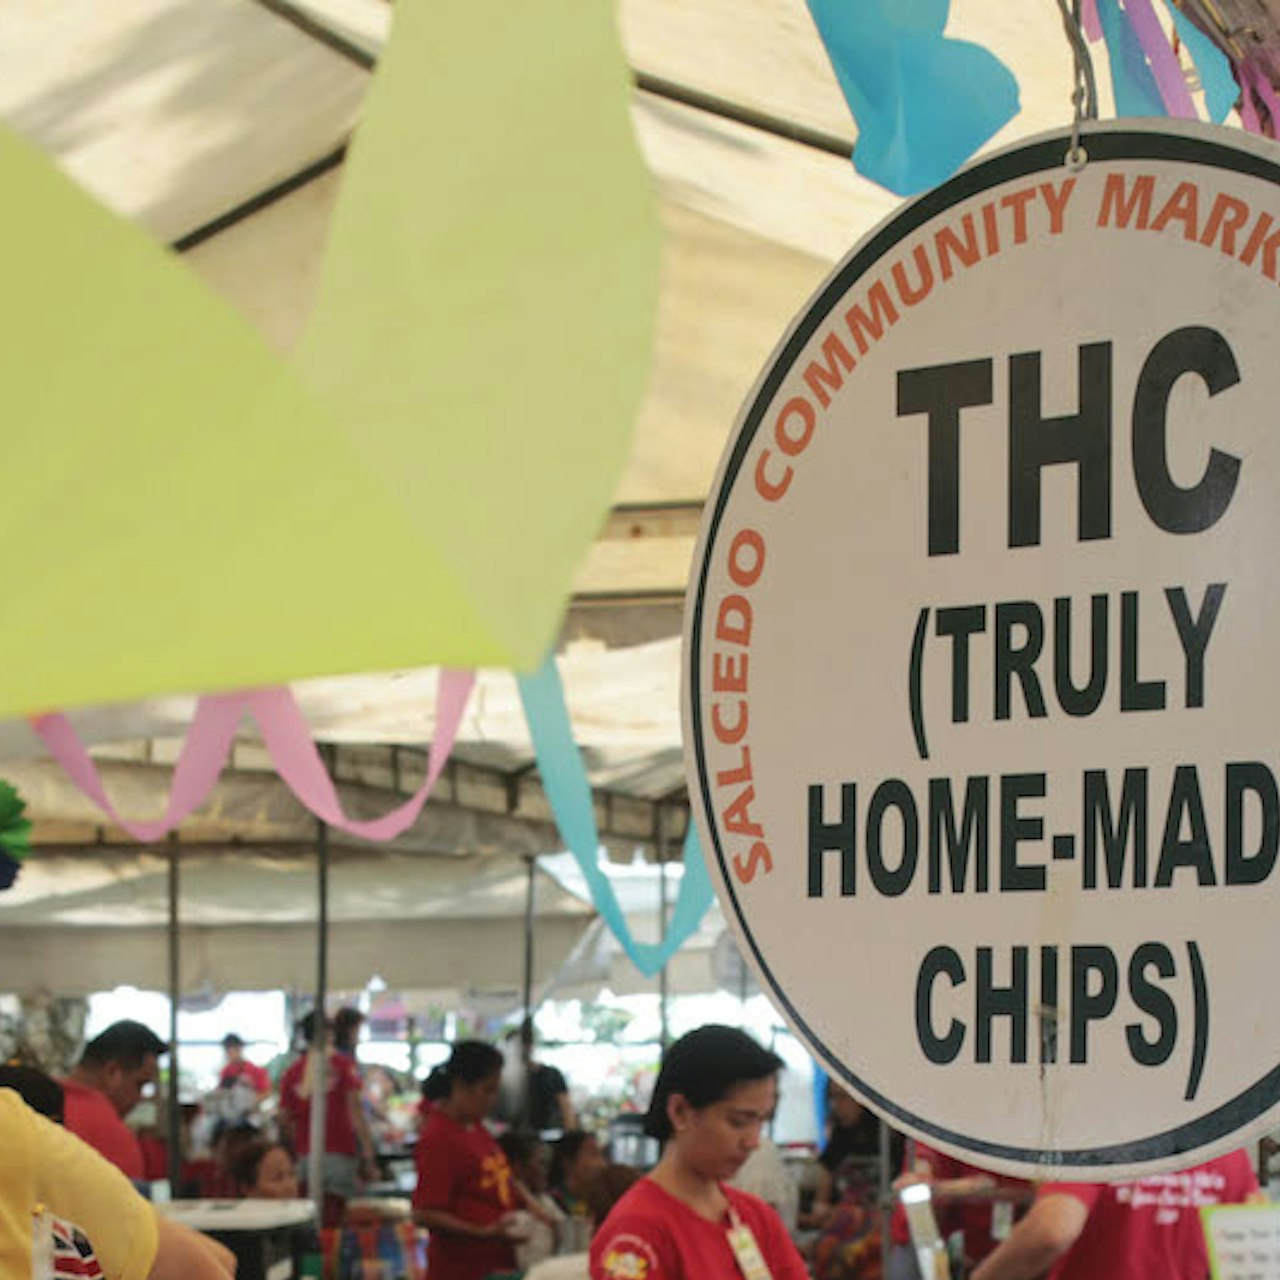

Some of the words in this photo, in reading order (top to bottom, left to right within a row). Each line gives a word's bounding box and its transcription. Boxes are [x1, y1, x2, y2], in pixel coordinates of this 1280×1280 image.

[711, 527, 774, 885] SALCEDO
[754, 176, 1078, 503] COMMUNITY
[896, 325, 1242, 557] THC
[908, 583, 1227, 760] (TRULY
[915, 940, 1209, 1101] CHIPS)
